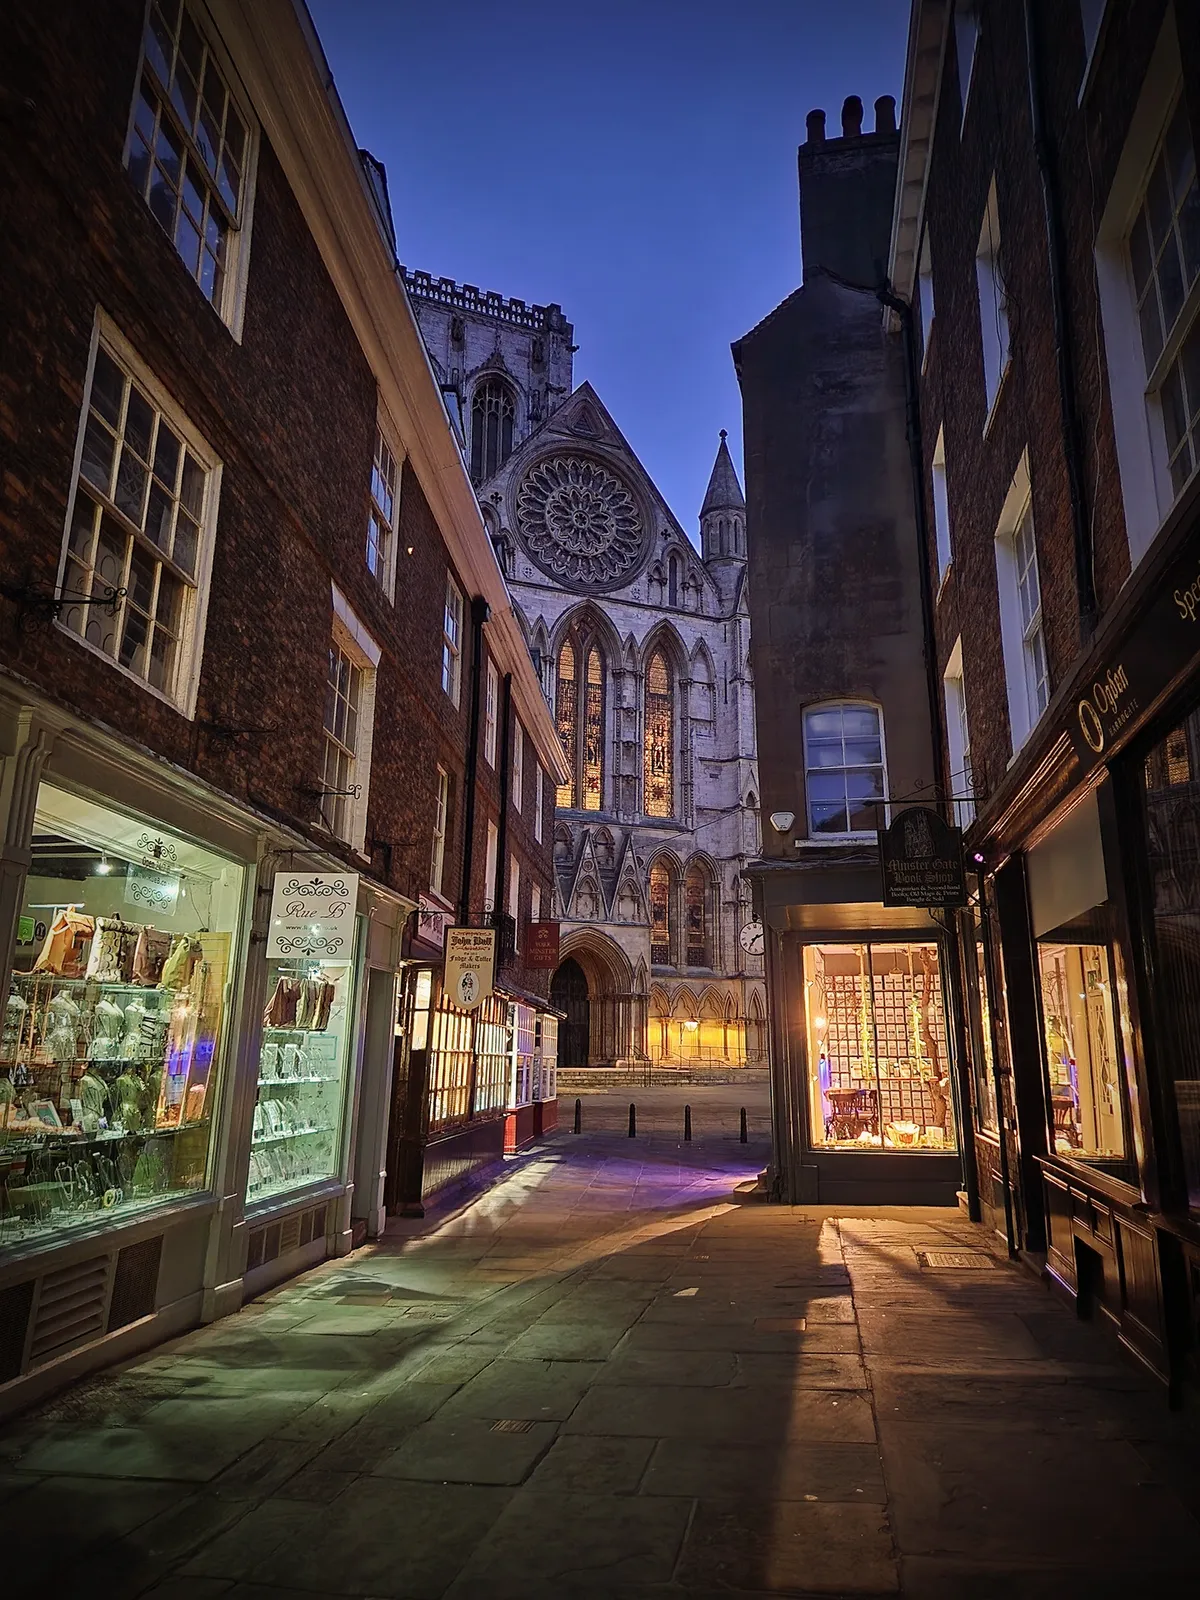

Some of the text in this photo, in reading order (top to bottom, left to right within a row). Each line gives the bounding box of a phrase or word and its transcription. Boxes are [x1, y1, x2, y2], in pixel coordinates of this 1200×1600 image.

[1093, 664, 1129, 714] Ogden
[888, 858, 958, 873] Minster Gate
[894, 871, 954, 884] Book Shop
[276, 900, 351, 918] Rue B
[451, 936, 492, 947] John Bull
[449, 955, 467, 963] Fudge
